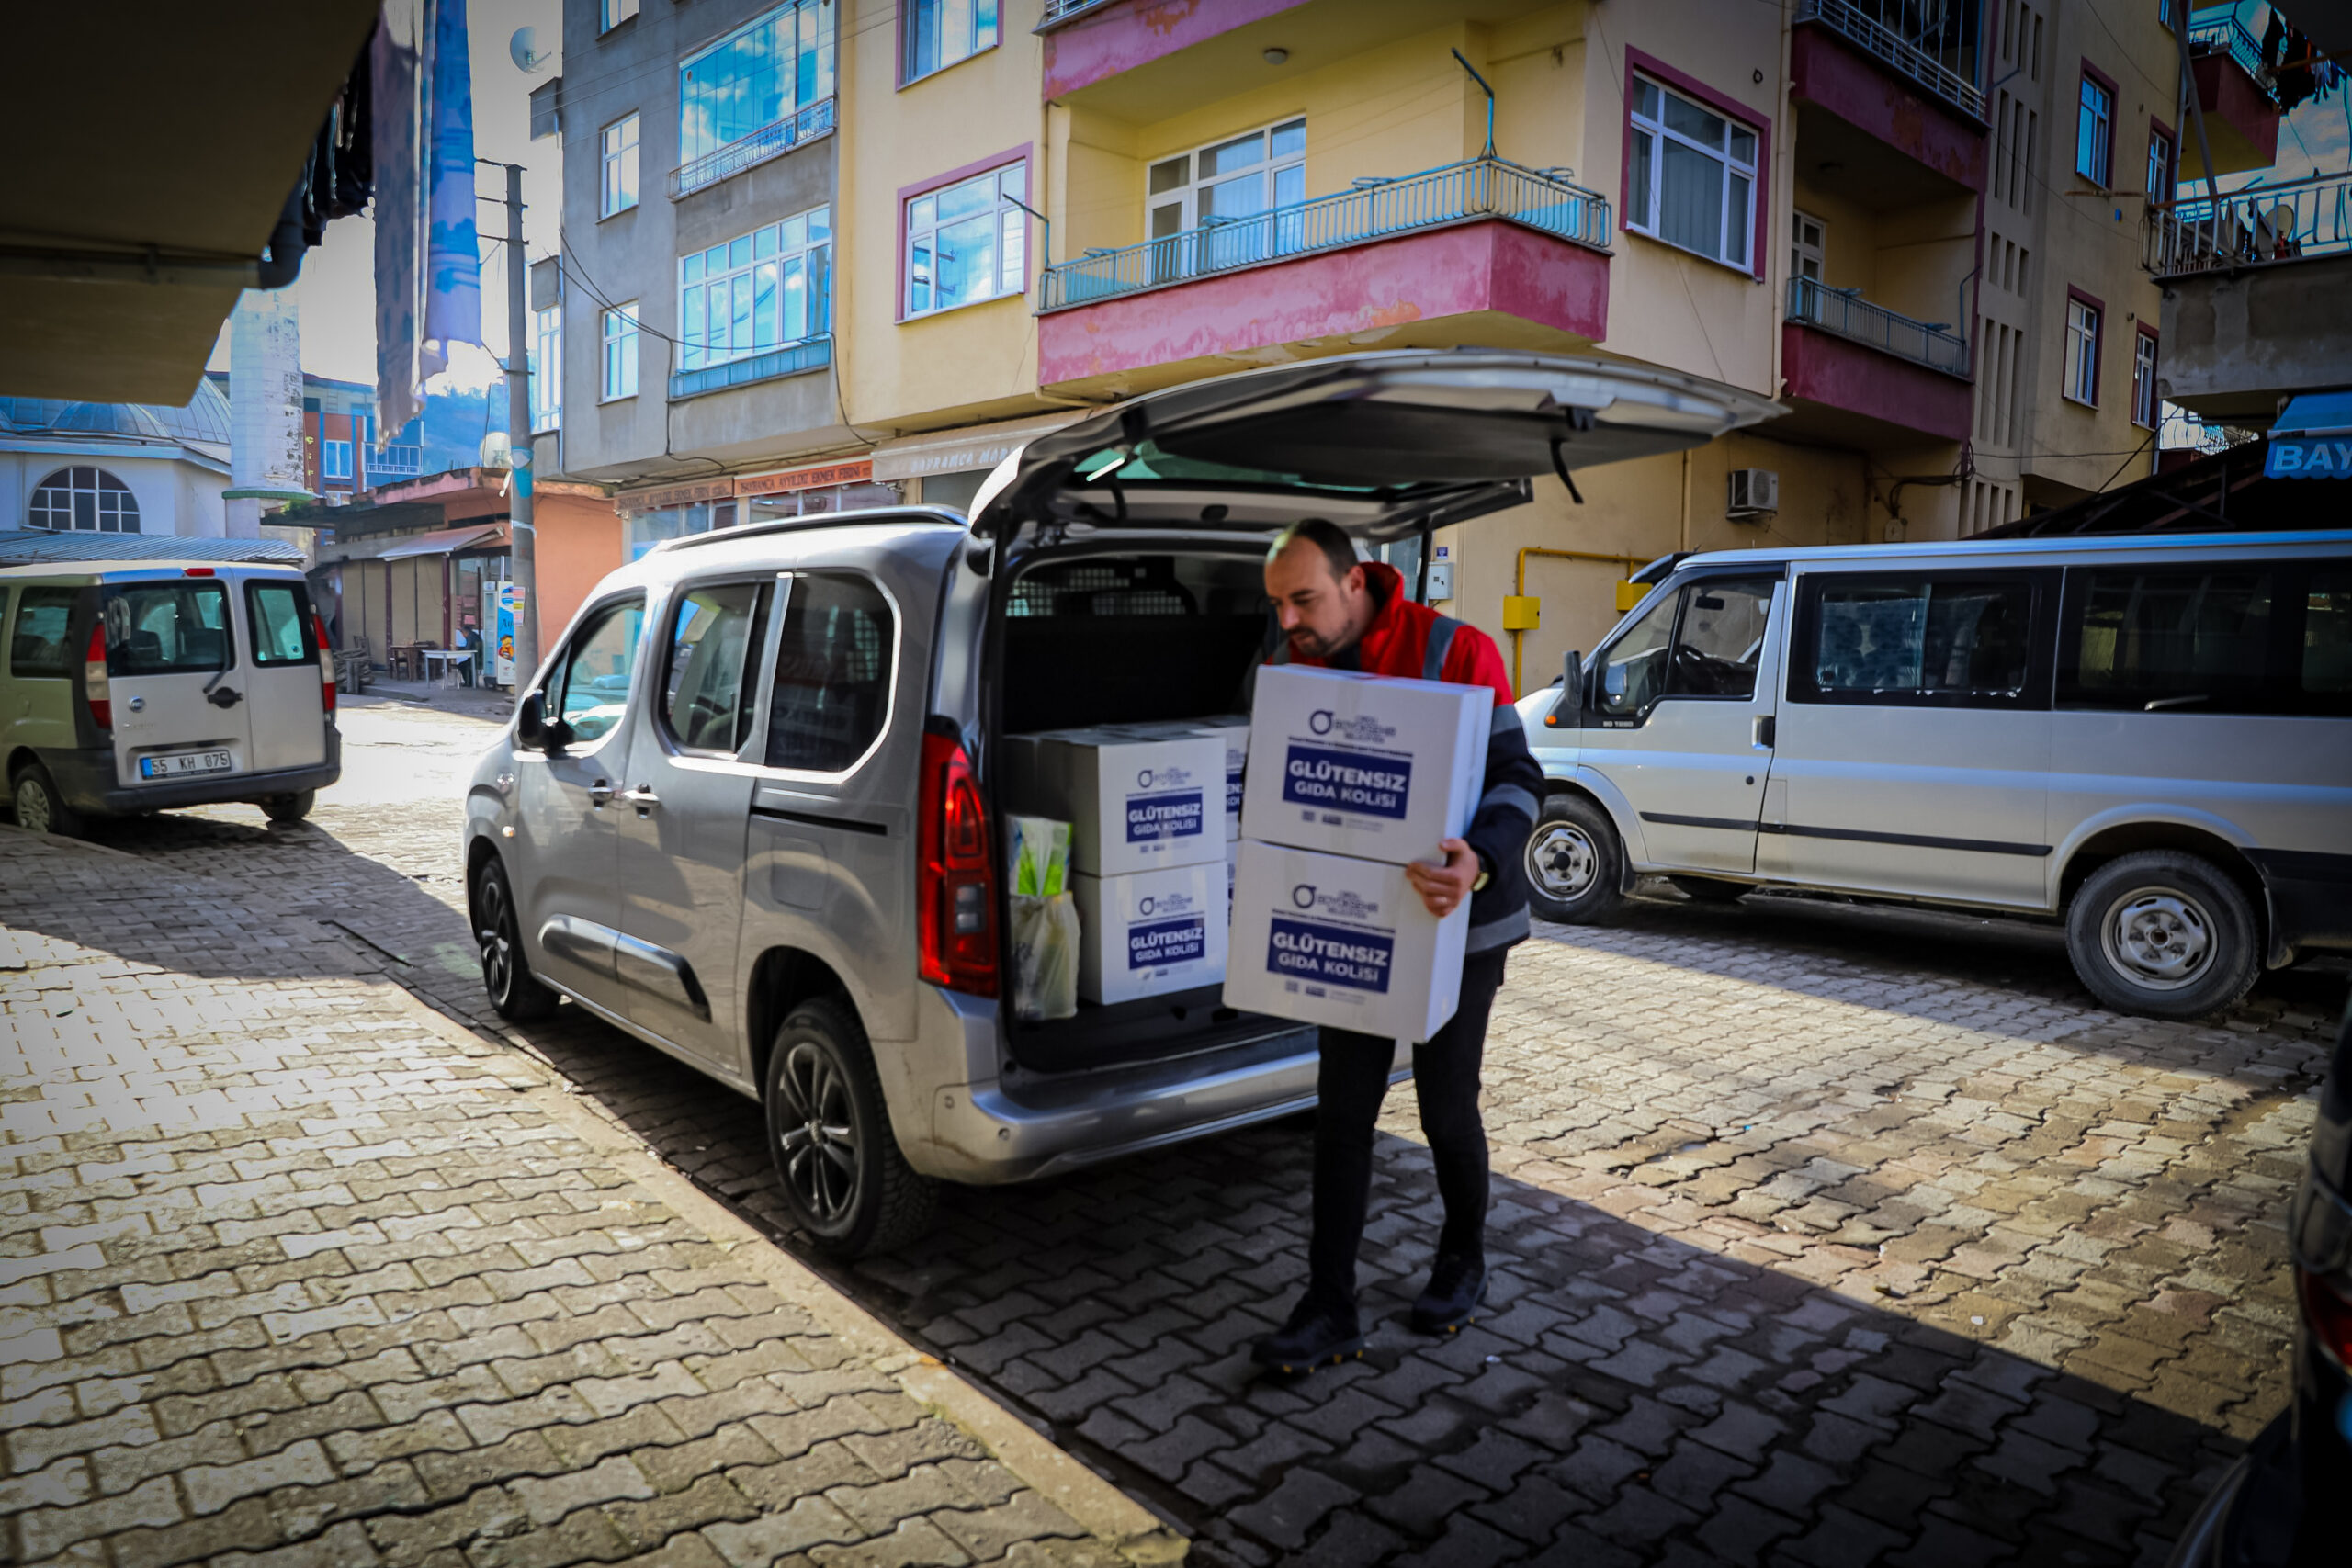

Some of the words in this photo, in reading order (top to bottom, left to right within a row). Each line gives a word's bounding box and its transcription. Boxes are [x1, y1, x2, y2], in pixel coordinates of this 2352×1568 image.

[812, 469, 836, 484] EKMEK
[152, 759, 168, 773] 55
[179, 756, 196, 771] KH
[205, 752, 228, 768] 875
[1288, 760, 1407, 793] GLÜTENSİZ
[1294, 780, 1337, 799] GIDA
[1341, 787, 1396, 808] KOLİSİ
[1128, 802, 1201, 823] GLÜTENSİZ
[1133, 822, 1161, 836] GIDA
[1130, 926, 1203, 950] GLÜTENSİZ
[1272, 931, 1389, 966] GLÜTENSİZ
[1136, 948, 1163, 962] GIDA
[1278, 952, 1319, 972] GIDA
[1324, 960, 1379, 982] KOLİSİ
